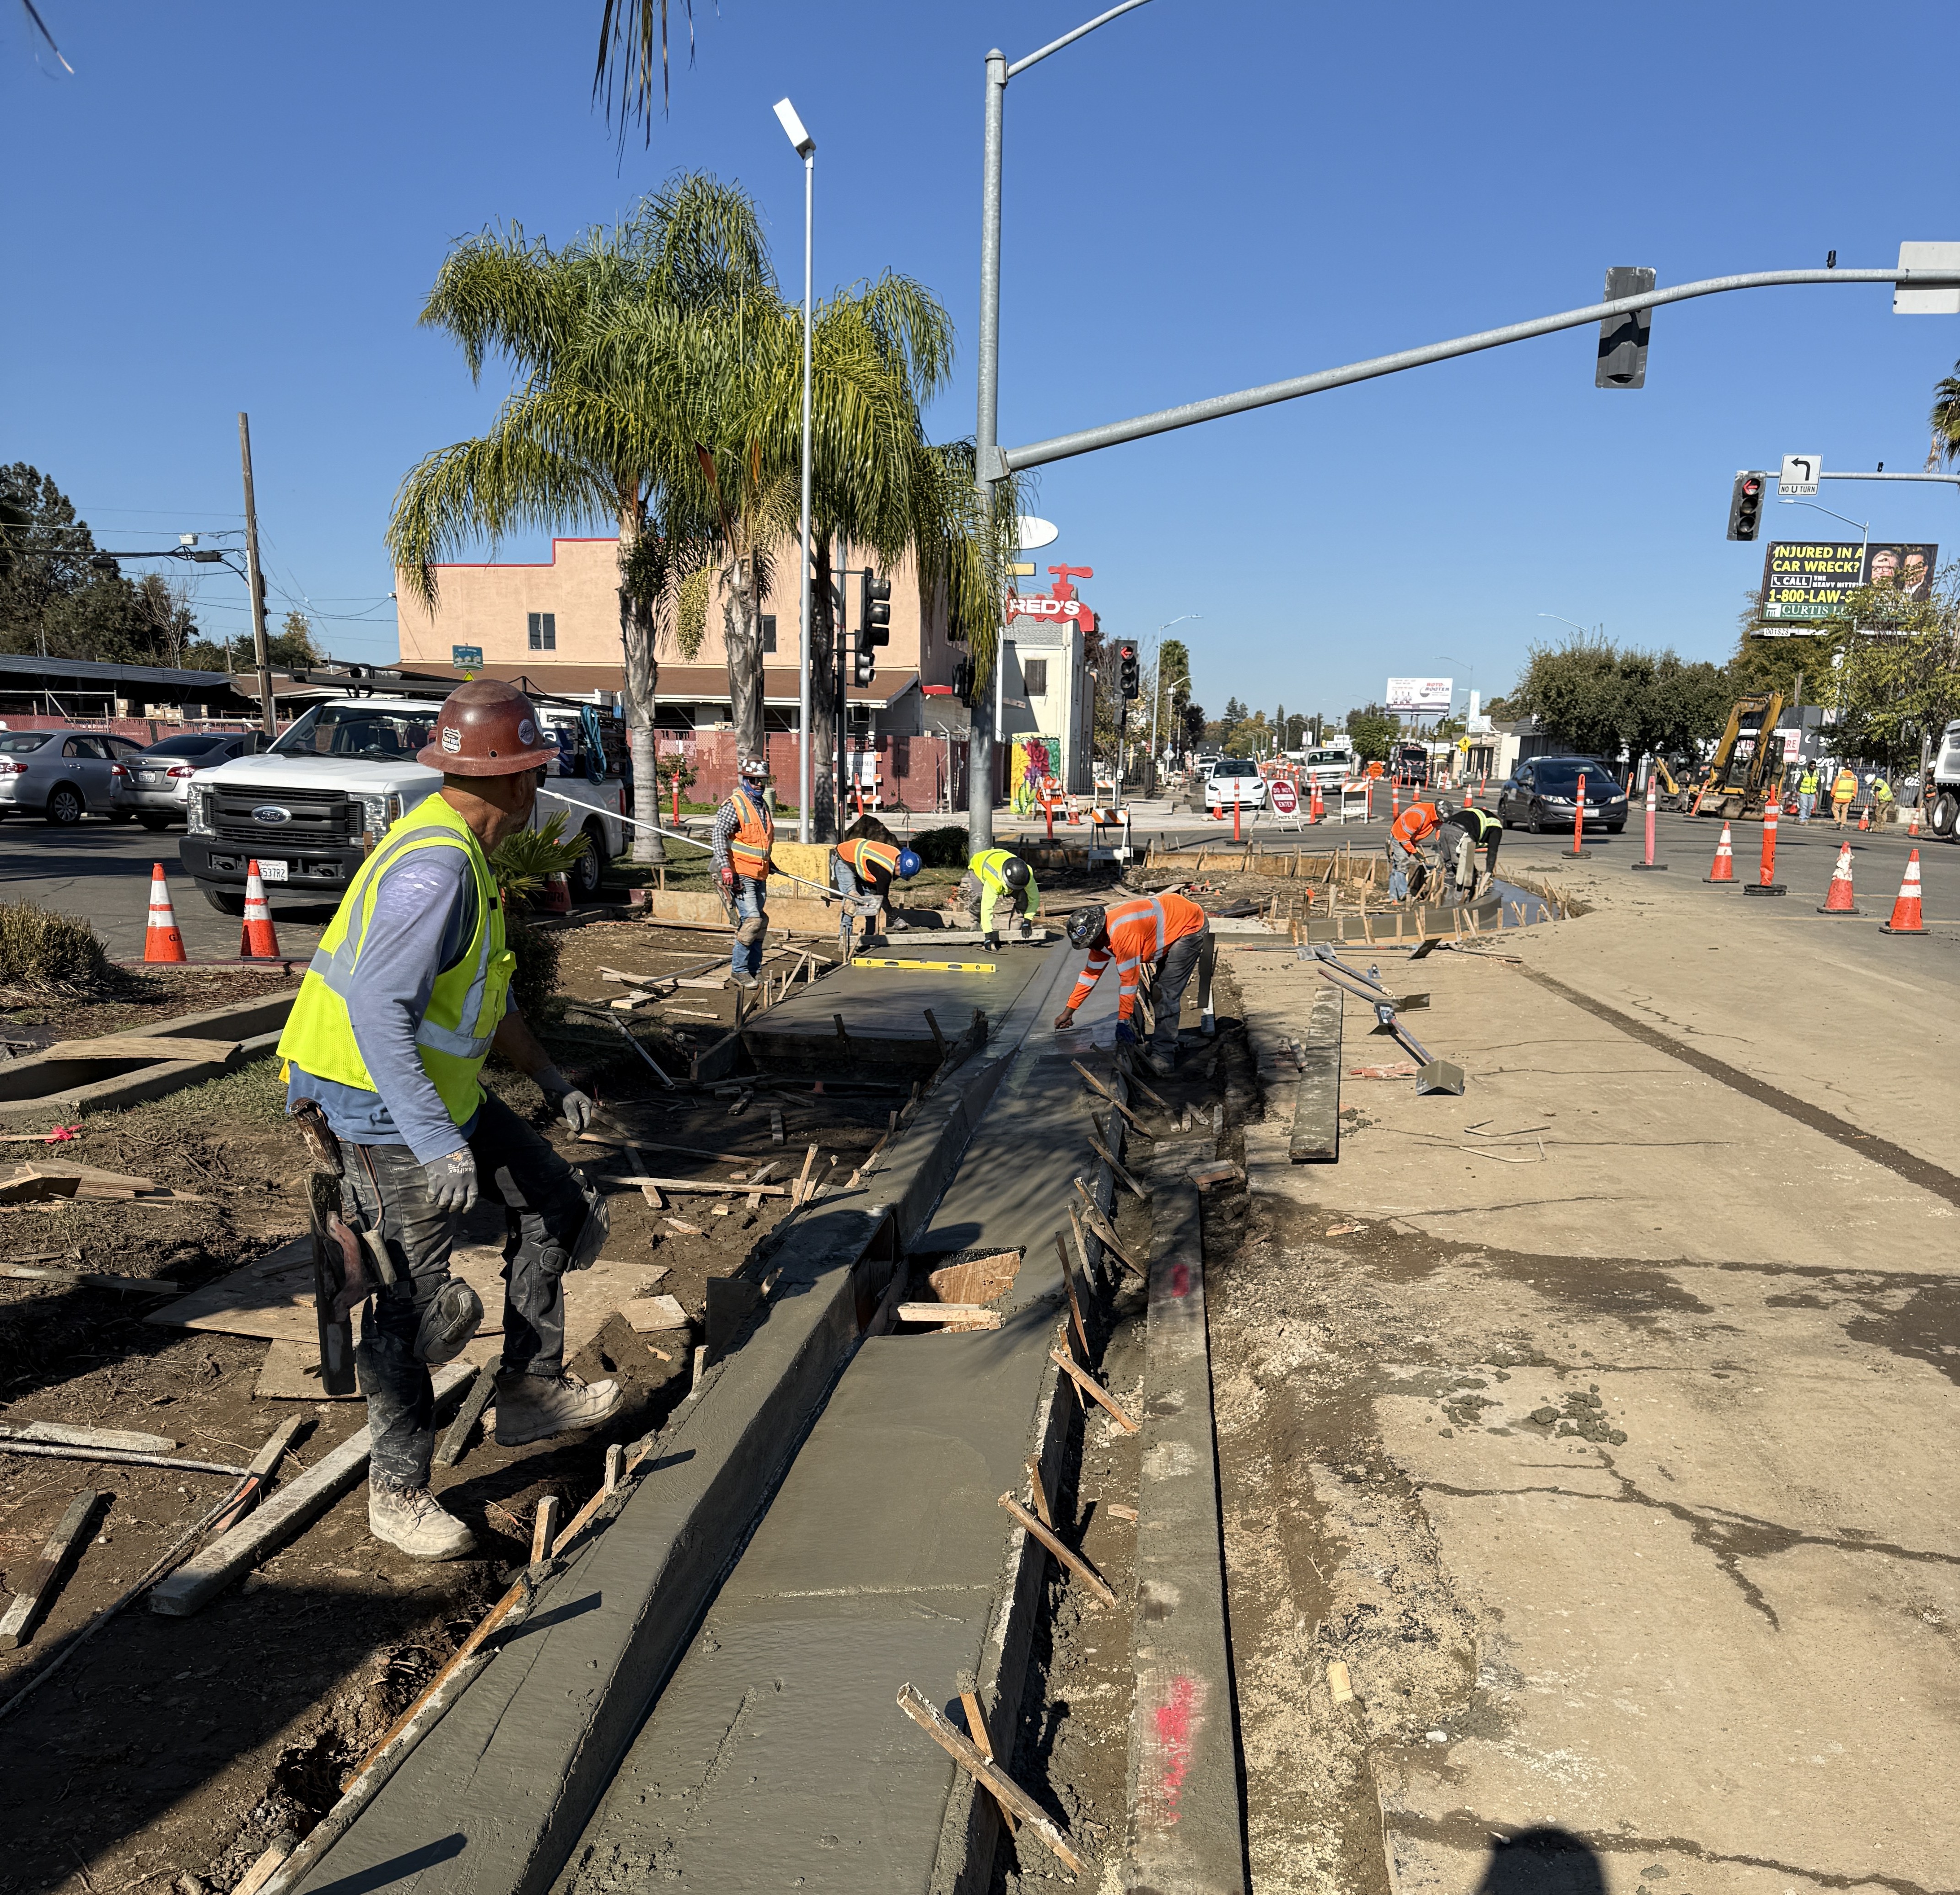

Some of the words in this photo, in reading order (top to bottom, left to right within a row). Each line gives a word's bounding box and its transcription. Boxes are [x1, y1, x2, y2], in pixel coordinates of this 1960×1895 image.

[1774, 546, 1833, 558] INJURED
[1836, 547, 1852, 558] IN
[1854, 547, 1863, 559] A
[1772, 560, 1800, 572] CAR
[1804, 561, 1860, 573] WRECK?
[1783, 577, 1807, 585] CALL
[1009, 598, 1081, 615] RED'S
[1782, 605, 1829, 615] CURTIS
[261, 811, 280, 820] Ford
